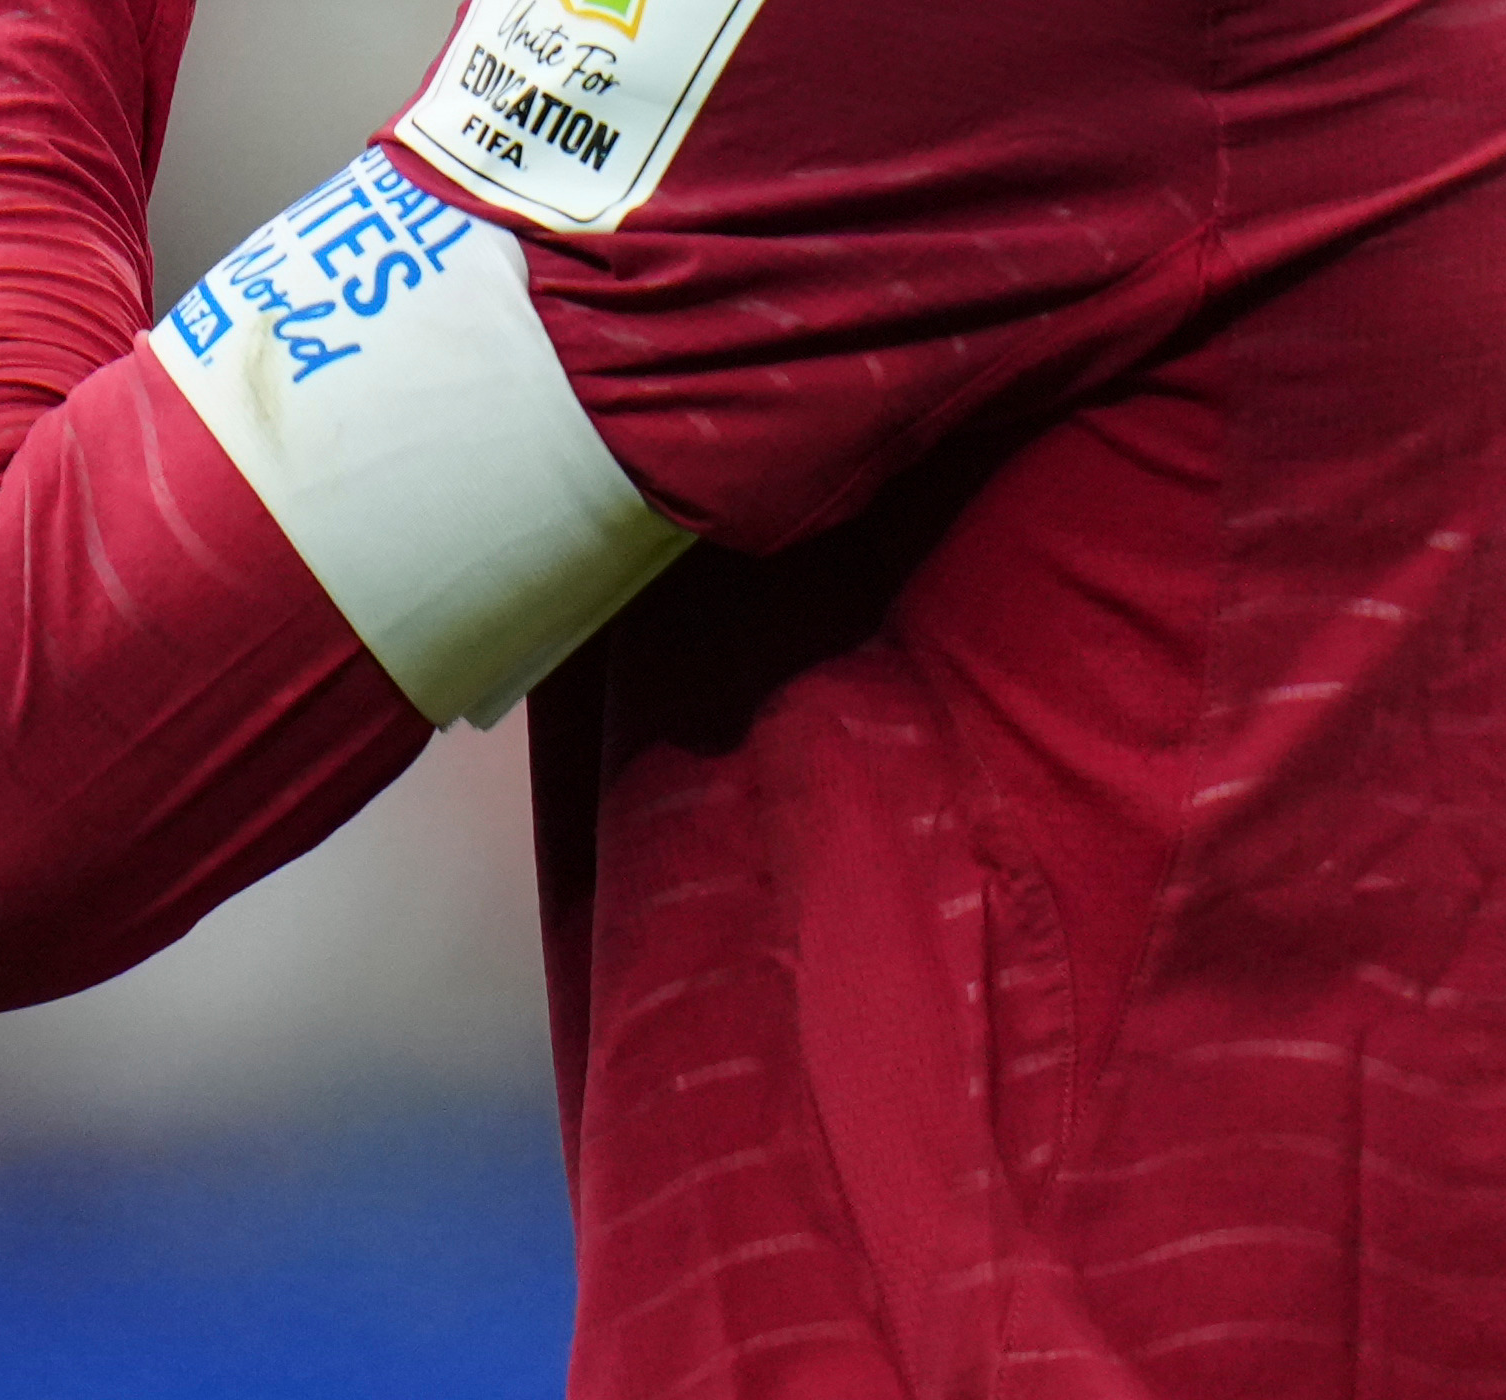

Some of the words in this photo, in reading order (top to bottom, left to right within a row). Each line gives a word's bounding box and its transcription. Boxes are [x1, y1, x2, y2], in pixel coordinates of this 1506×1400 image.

[460, 43, 620, 172] EDUCATION
[561, 43, 620, 95] For
[461, 114, 524, 169] FIFA
[221, 226, 362, 384] World
[284, 168, 422, 317] ITES
